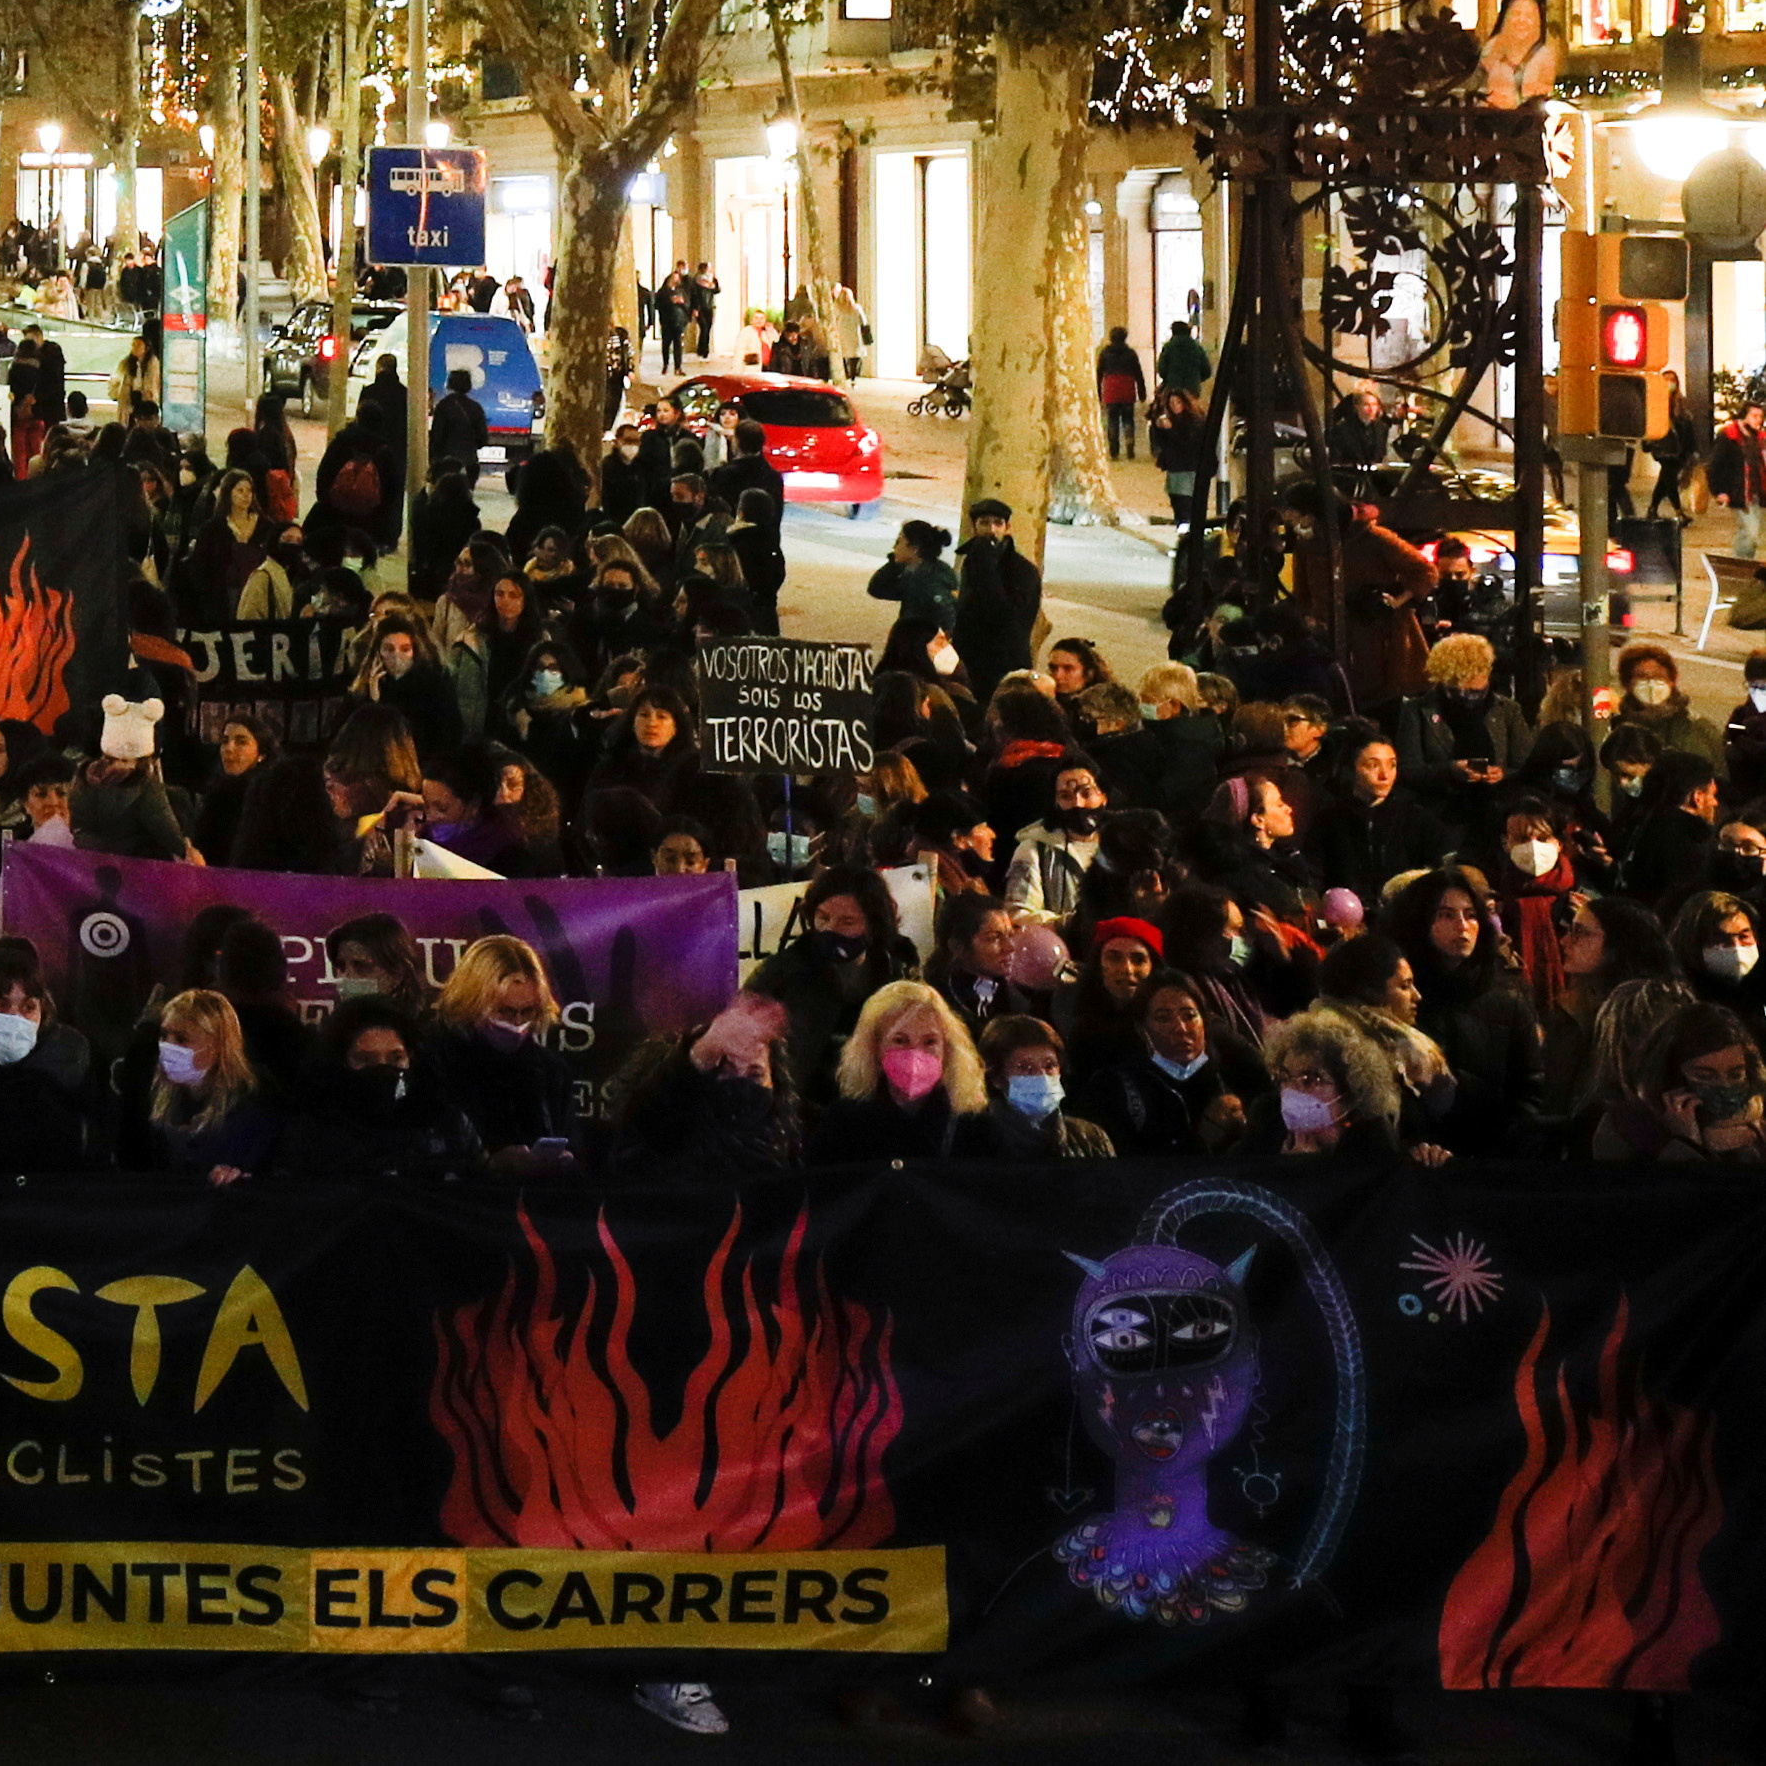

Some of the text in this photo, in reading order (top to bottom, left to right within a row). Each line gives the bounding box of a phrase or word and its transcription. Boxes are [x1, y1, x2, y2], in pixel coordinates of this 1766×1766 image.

[407, 225, 449, 249] taxi
[701, 644, 791, 685] VOSOTROS
[737, 684, 824, 712] SOIS LOS
[312, 1565, 459, 1630] ELS
[486, 1565, 892, 1634] CARRERS
